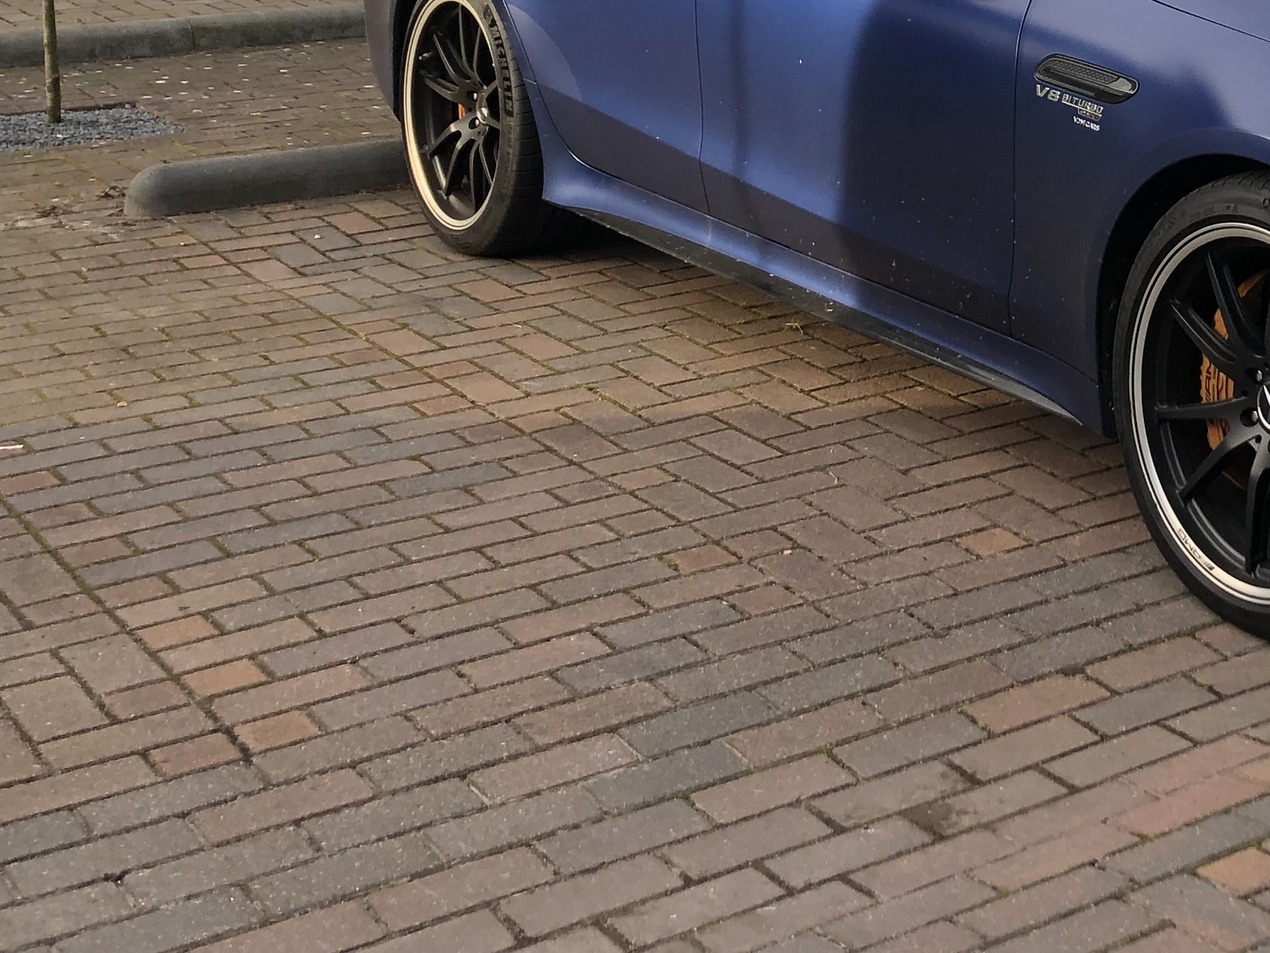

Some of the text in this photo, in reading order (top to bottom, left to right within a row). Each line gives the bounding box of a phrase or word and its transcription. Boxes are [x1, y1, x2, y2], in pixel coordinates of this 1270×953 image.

[489, 24, 514, 115] MICHELIN
[1035, 84, 1104, 114] V8 BITURBO
